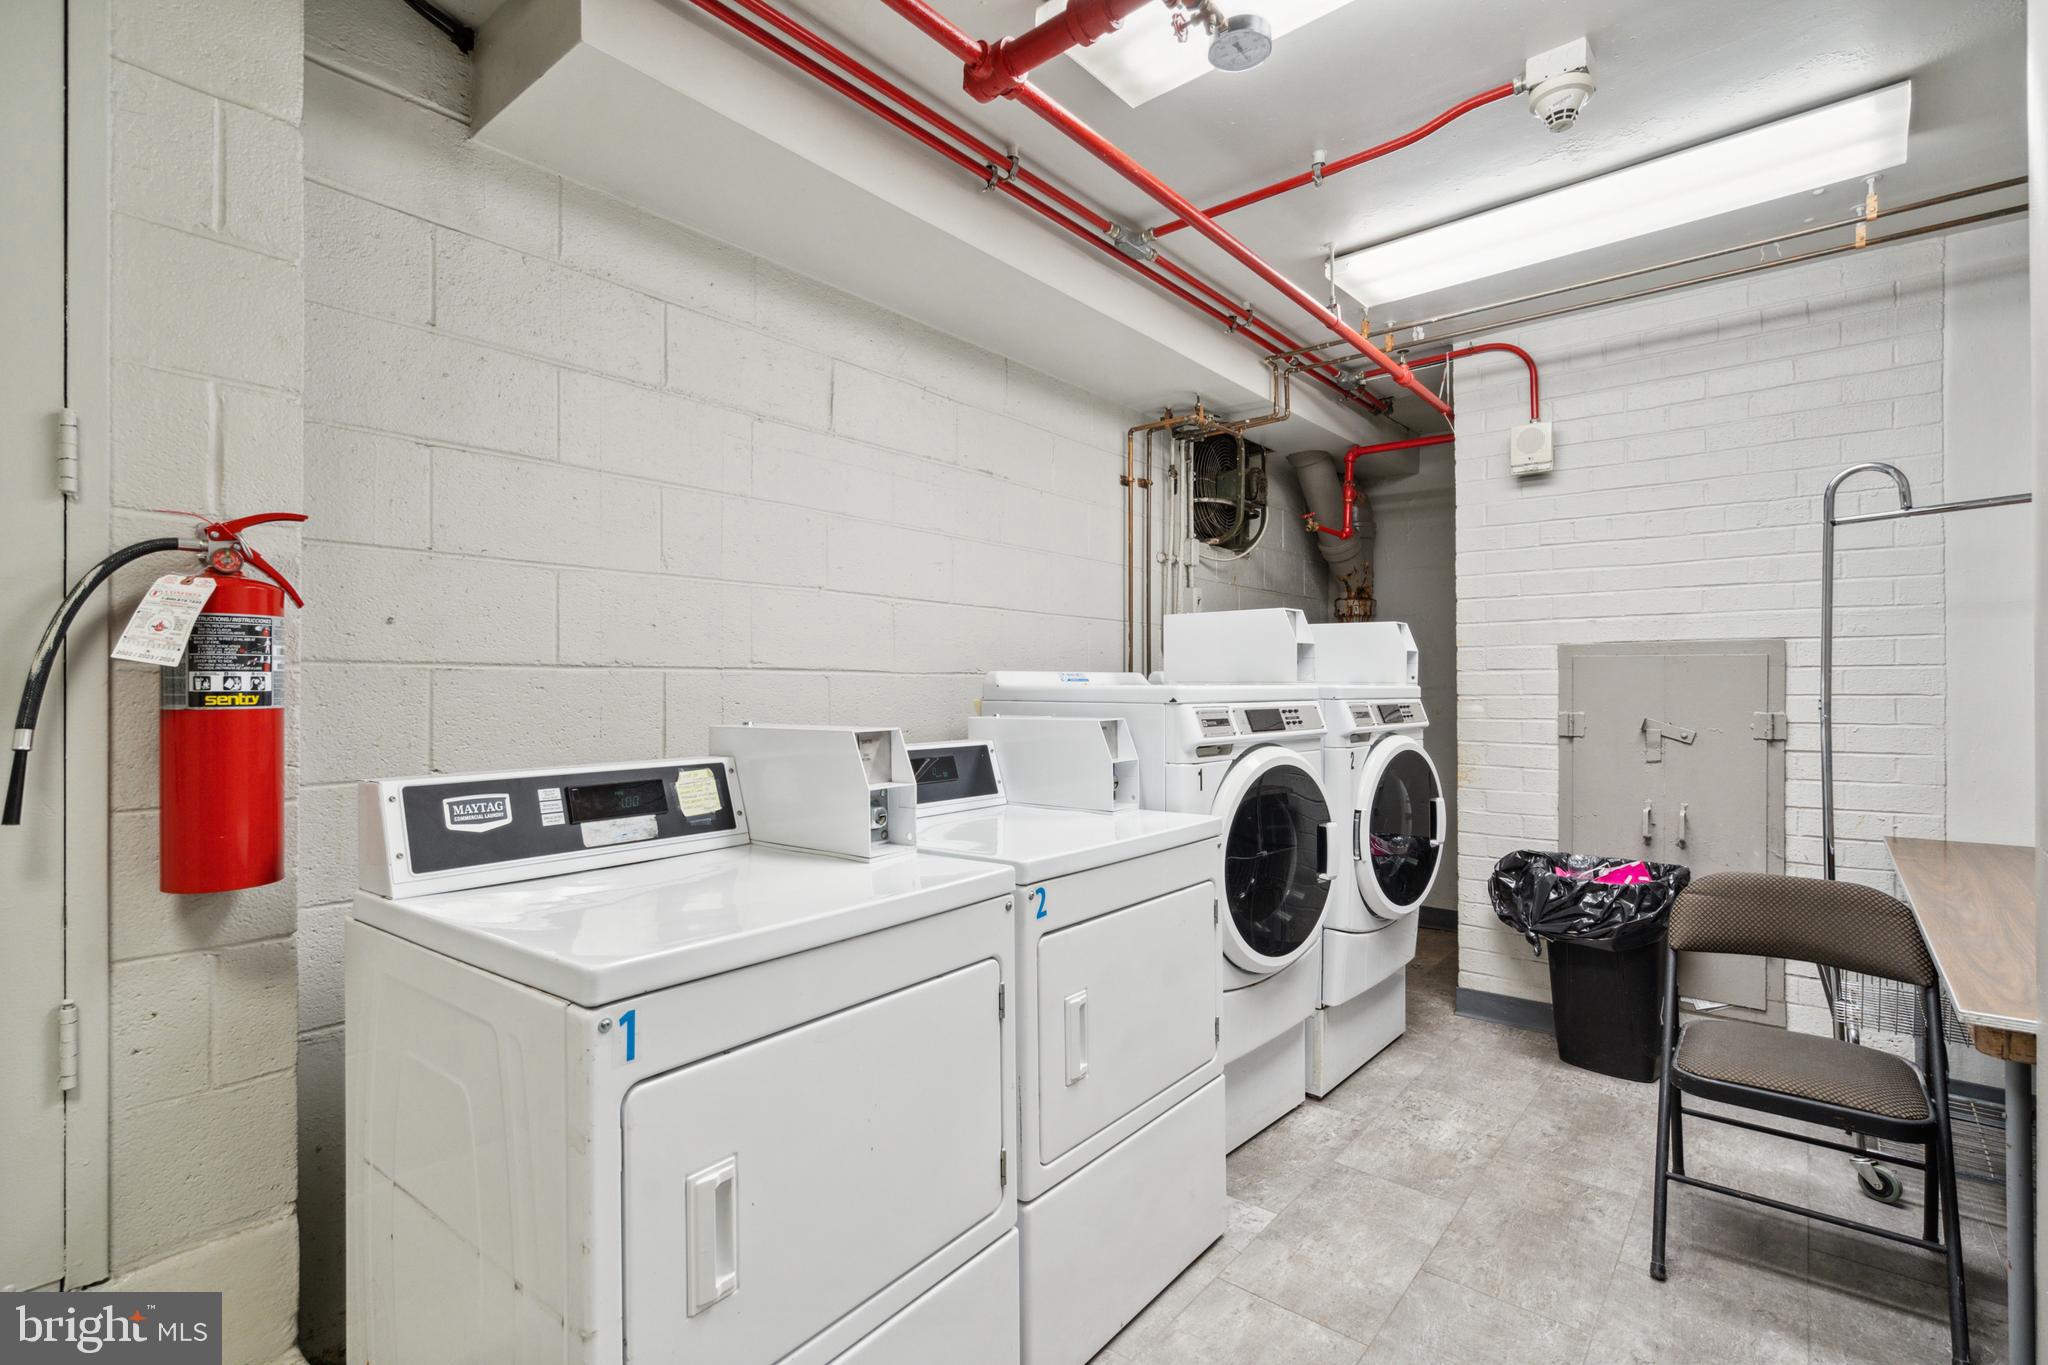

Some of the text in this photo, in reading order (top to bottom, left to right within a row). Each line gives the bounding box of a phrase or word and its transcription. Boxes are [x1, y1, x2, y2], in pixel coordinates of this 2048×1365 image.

[205, 693, 259, 705] sentry
[1350, 752, 1355, 770] 2
[1198, 768, 1203, 791] 1
[452, 801, 503, 815] MAYTAG
[1035, 887, 1047, 920] 2
[619, 1009, 636, 1062] 1
